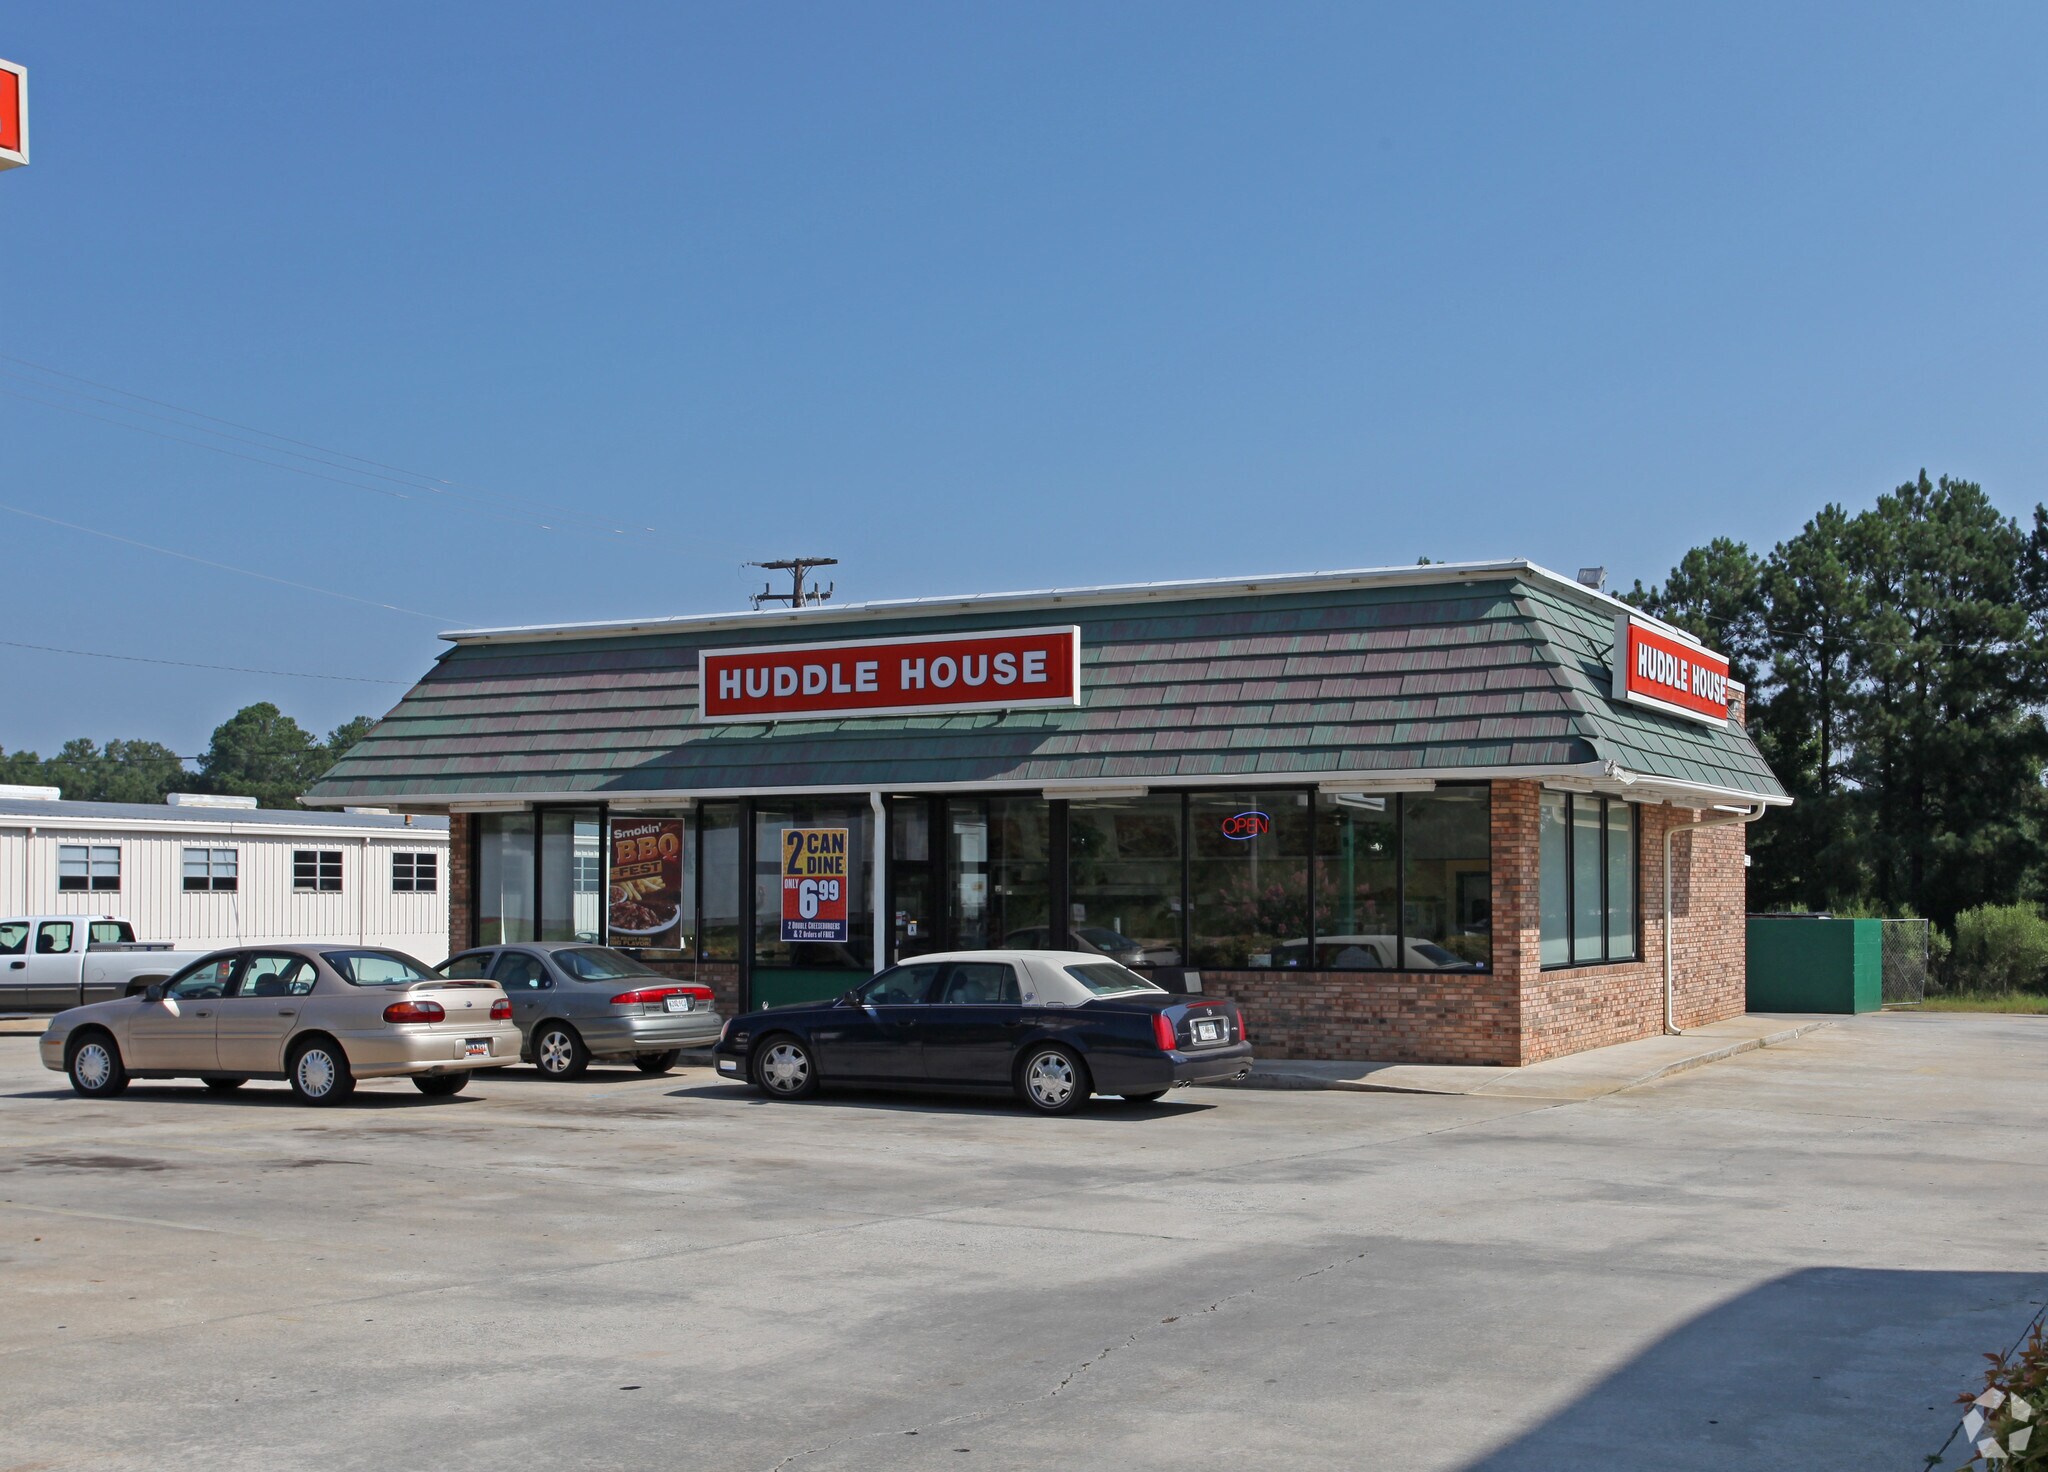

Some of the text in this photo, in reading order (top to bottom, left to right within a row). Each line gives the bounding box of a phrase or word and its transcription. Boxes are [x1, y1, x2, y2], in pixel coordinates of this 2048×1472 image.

[719, 650, 1047, 699] HUDDLE HOUSE
[1638, 642, 1727, 706] HUDDLE HOUSE
[613, 822, 662, 839] Smokin'
[1222, 817, 1268, 834] OPEN
[615, 832, 679, 864] BBQ
[786, 831, 844, 875] 2 CAN
[619, 861, 660, 877] FEST
[807, 856, 843, 874] DINE
[784, 878, 799, 889] ONLY
[788, 921, 792, 930] 2
[799, 930, 802, 938] 2
